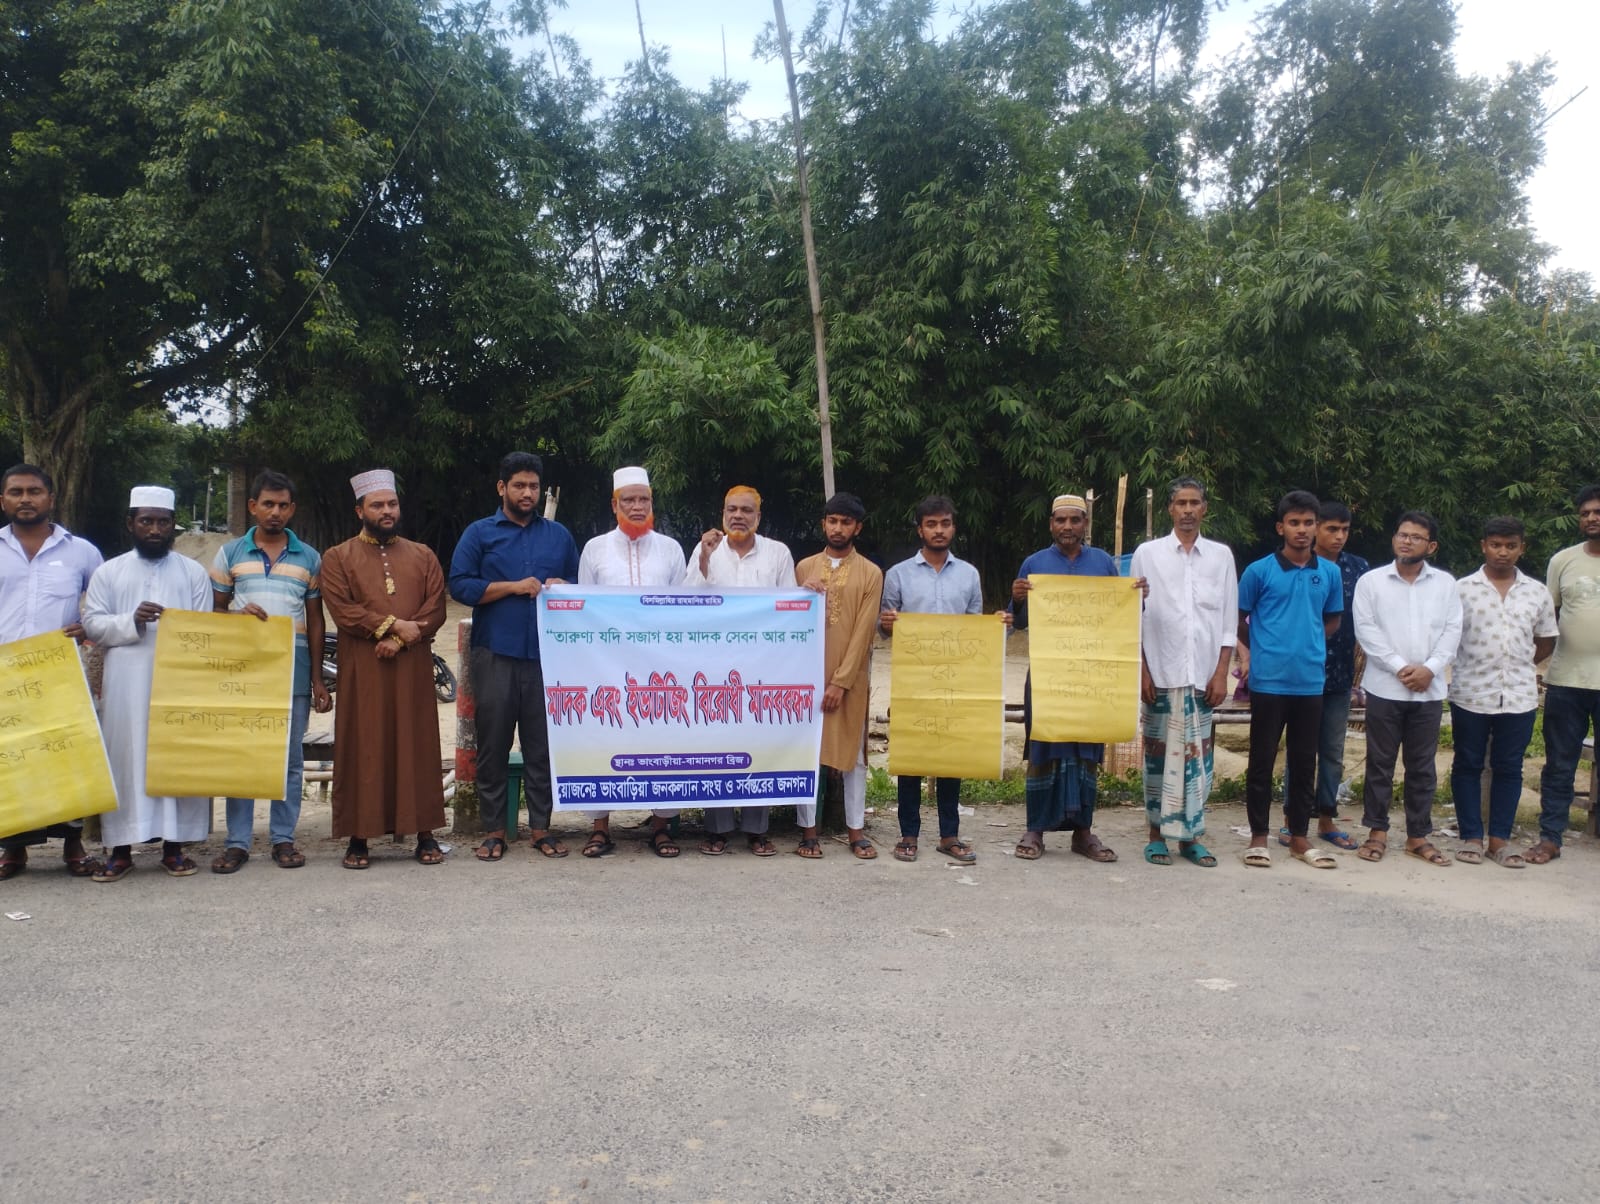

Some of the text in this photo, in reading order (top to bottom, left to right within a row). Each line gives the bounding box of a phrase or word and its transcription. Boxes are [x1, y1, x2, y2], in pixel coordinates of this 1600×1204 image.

[548, 601, 568, 609] আমার
[599, 627, 622, 645] যদি
[625, 630, 661, 644] সজাগ
[665, 631, 683, 643] হয়
[687, 630, 721, 644] মাদক
[725, 631, 758, 644] সেবন
[762, 630, 786, 644] আর
[199, 655, 253, 677] মাদক
[930, 662, 961, 681] কে
[545, 669, 815, 729] মাদক এবং ইভটিজিং বিরোধী মানববন্ধন
[557, 780, 597, 799] য়োজনেঃ
[599, 776, 649, 800] ভাংবাড়িয়া
[701, 779, 722, 797] সংঘ
[725, 780, 734, 794] ও
